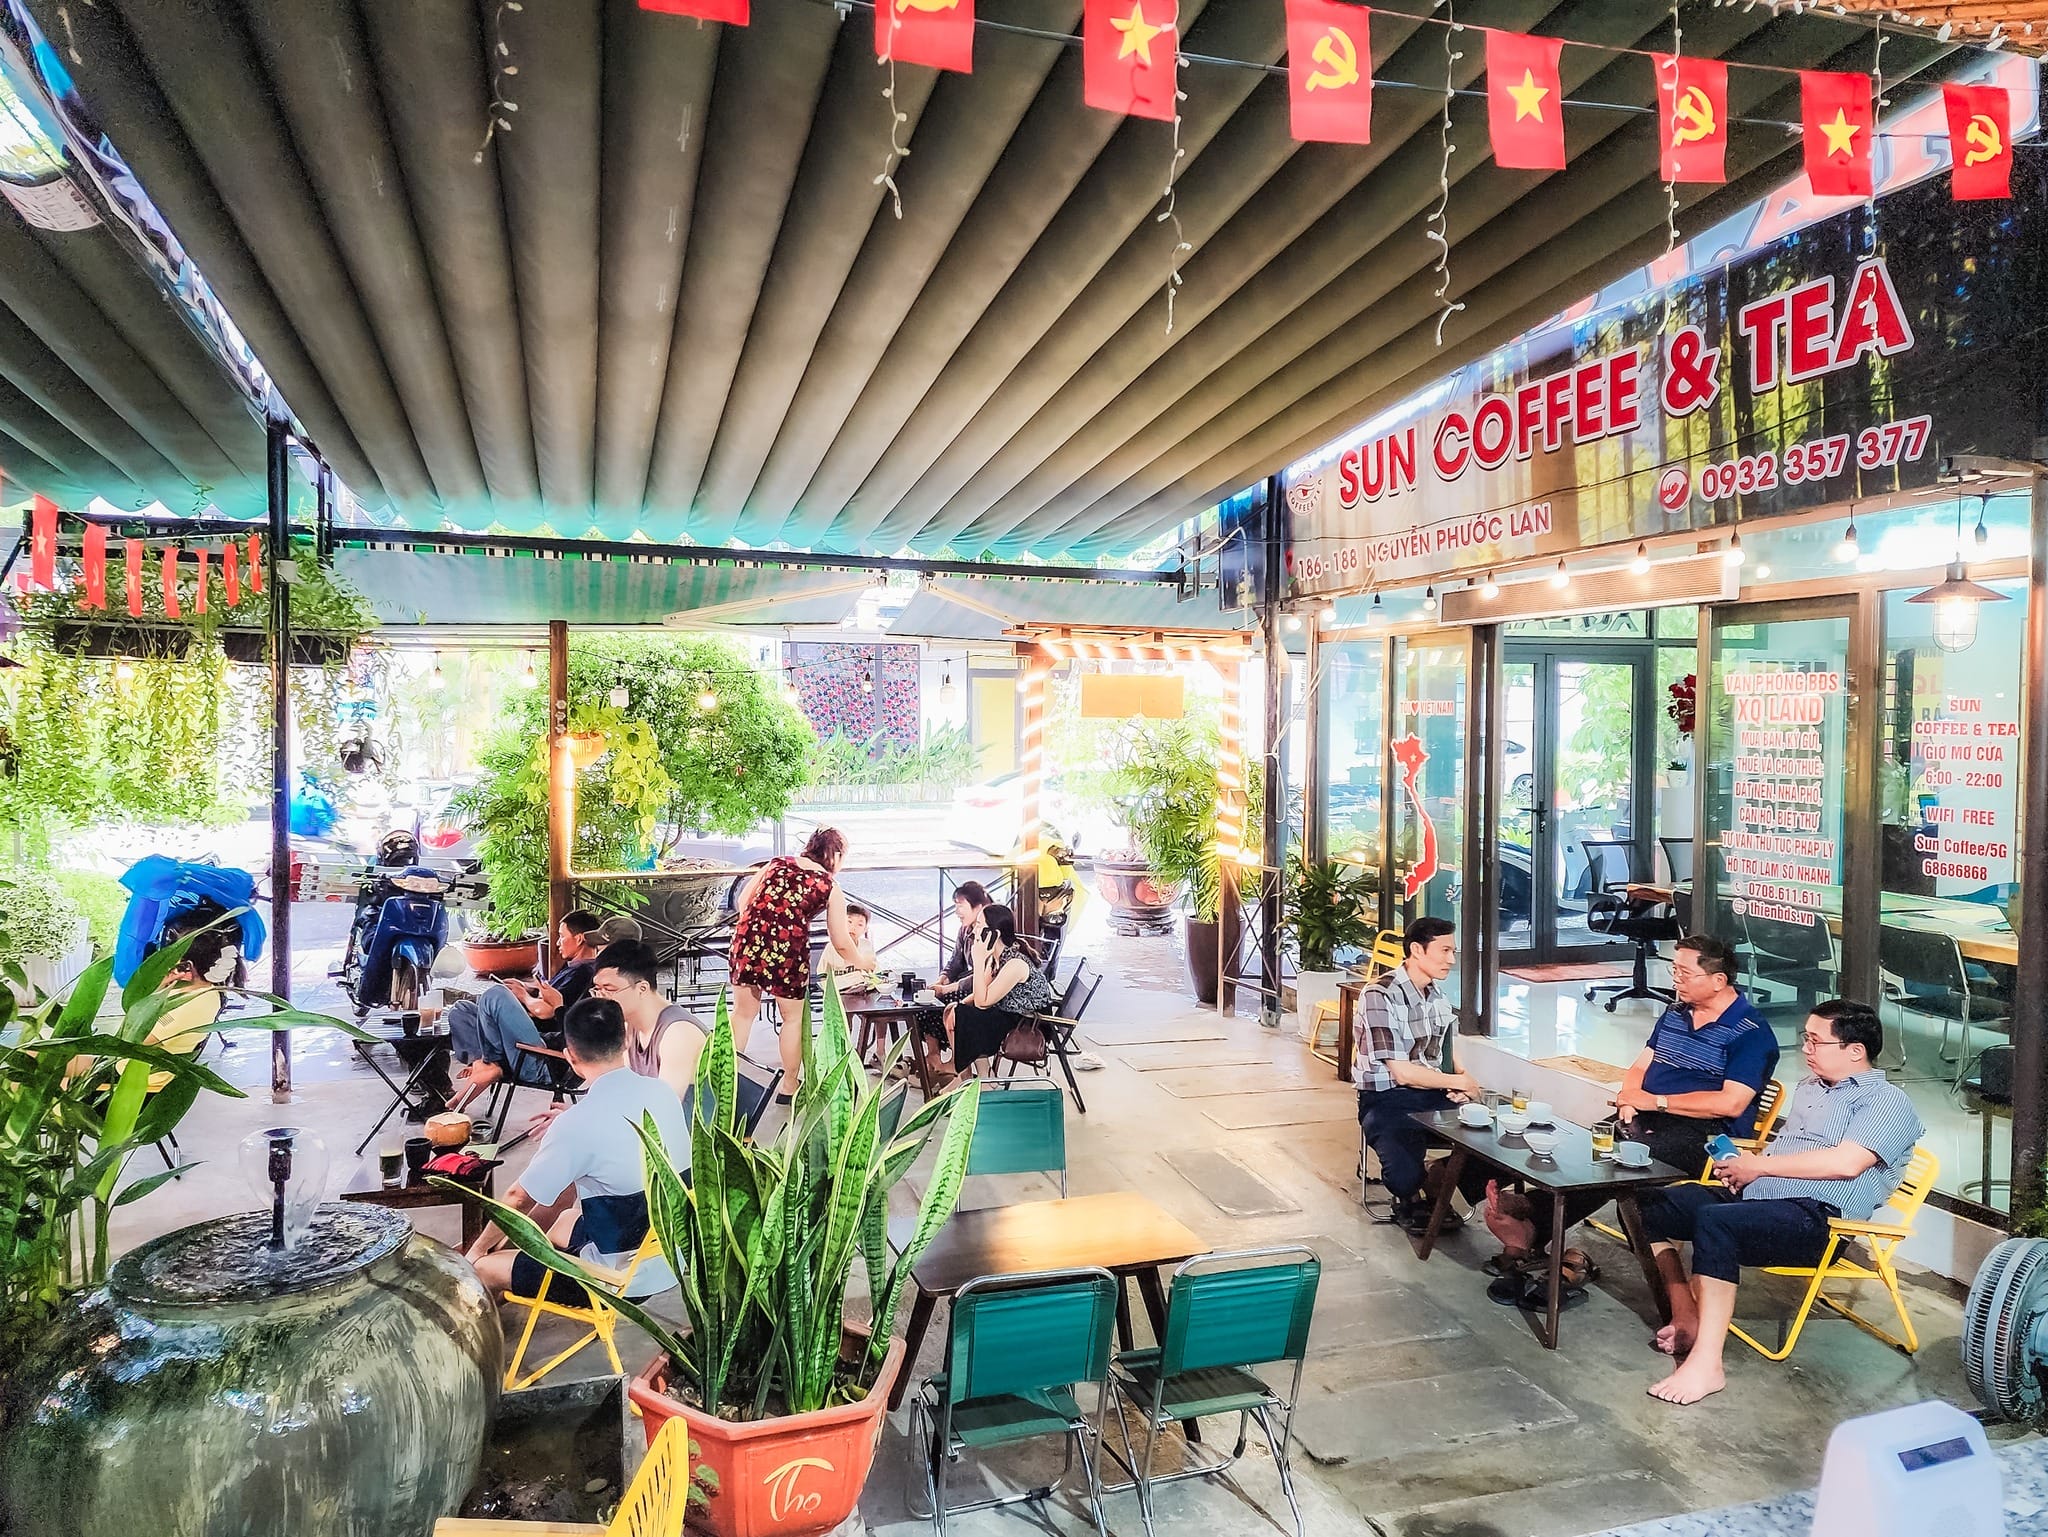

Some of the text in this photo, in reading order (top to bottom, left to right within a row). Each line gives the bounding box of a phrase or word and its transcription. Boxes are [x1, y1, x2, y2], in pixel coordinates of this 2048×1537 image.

[1338, 260, 1911, 507] SUN COFFEE & TEA
[1701, 417, 1930, 499] 0932 357 377
[1366, 525, 1431, 567] NGUYỄN
[1436, 514, 1503, 552] PHƯỚC
[1510, 503, 1551, 537] LAN
[1737, 697, 1821, 724] XQ LAND
[1950, 699, 1981, 712] SUN
[1741, 731, 1760, 746] MUA
[1915, 722, 2018, 736] COFFEE & TEA
[1775, 758, 1795, 774] CHO
[1925, 770, 1952, 784] 6:00
[1966, 772, 2002, 788] 22:00
[1927, 807, 1954, 823] WIFI
[1963, 809, 1995, 825] FREE
[1916, 835, 2008, 858] Sun Coffee/5G
[1797, 866, 1831, 885] NHANH
[1924, 860, 1988, 881] 68686868
[1748, 882, 1822, 907] 0708.611.611
[763, 1457, 835, 1522] Thọ
